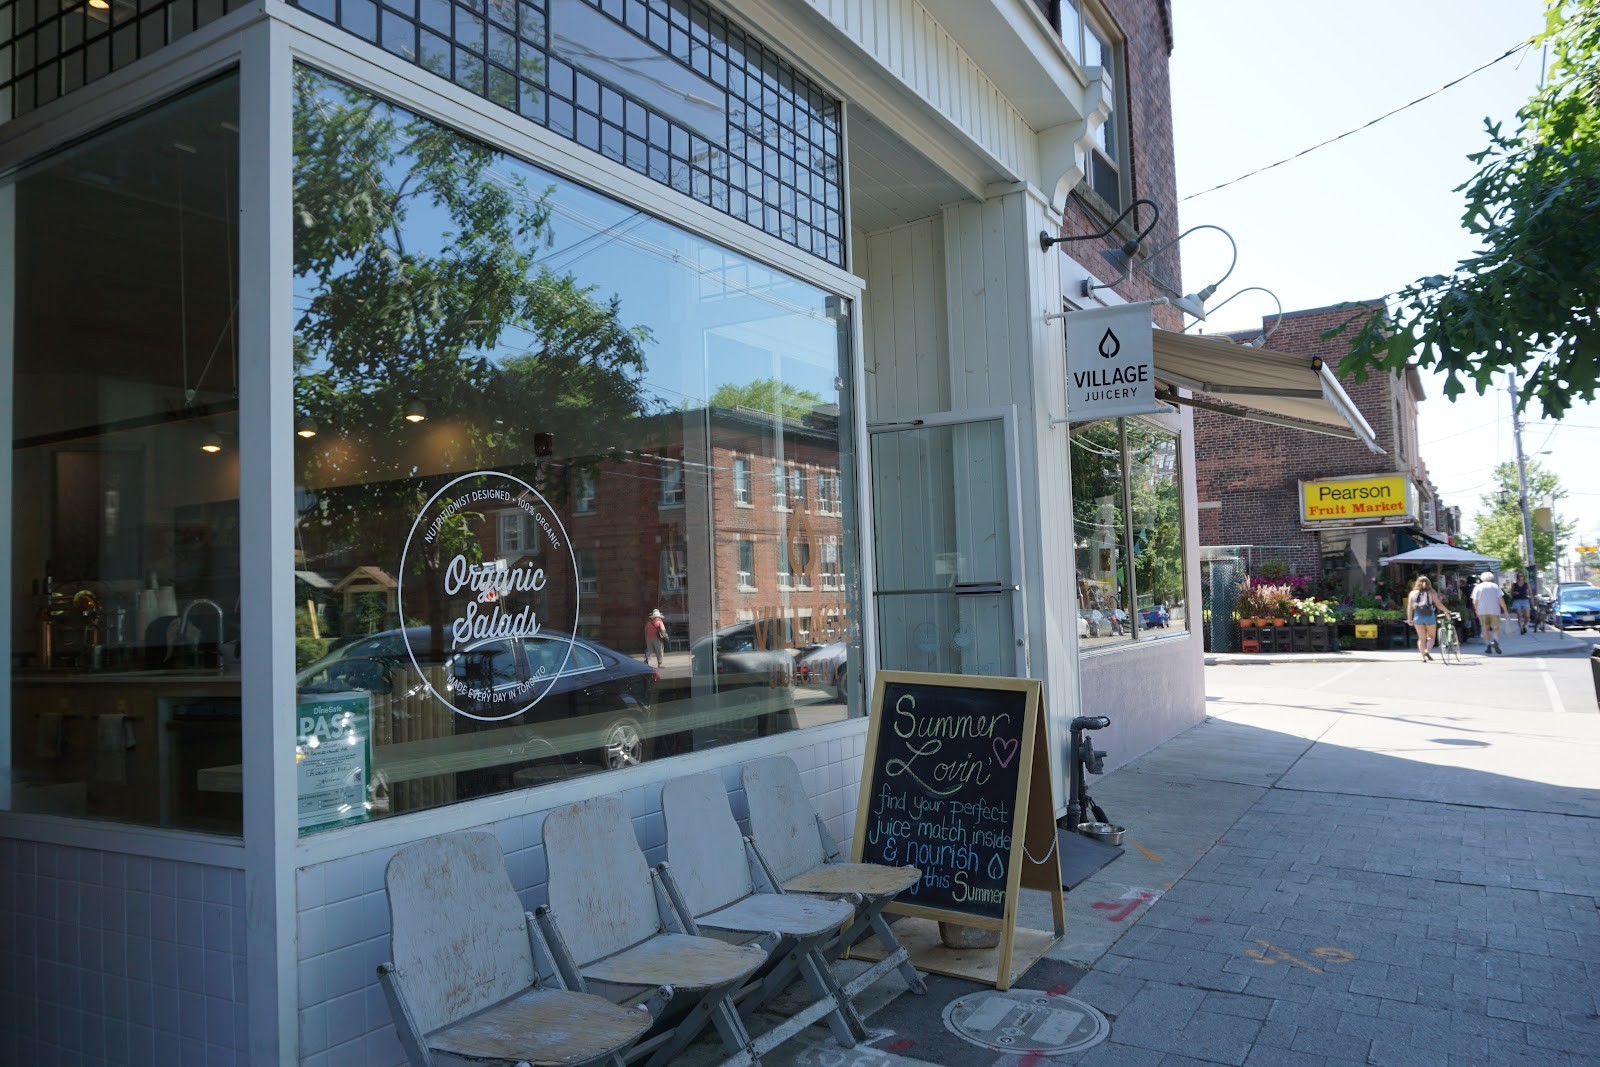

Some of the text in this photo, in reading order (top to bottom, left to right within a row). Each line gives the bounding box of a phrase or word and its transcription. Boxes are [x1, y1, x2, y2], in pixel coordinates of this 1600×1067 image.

[1073, 364, 1148, 388] VILLAGE
[1084, 387, 1138, 402] JUICERY
[1308, 501, 1404, 516] Fruit Market
[1319, 485, 1391, 501] Pearson
[424, 489, 561, 550] NUTRITIONIST DESIGNED 100% ORGANIC
[444, 553, 547, 603] Organic
[452, 601, 541, 650] Salads
[752, 602, 852, 650] VILLAGE
[446, 665, 546, 703] MADE EVERY DAY IN TORONTO
[313, 705, 343, 715] DineSafe
[893, 694, 1011, 739] Summer
[885, 739, 992, 795] Lovin'
[874, 782, 906, 815] find
[909, 796, 945, 820] your
[869, 816, 1012, 850] juice match inside
[883, 837, 979, 873] & nourish
[924, 866, 950, 889] this
[952, 871, 1006, 904] Summer
